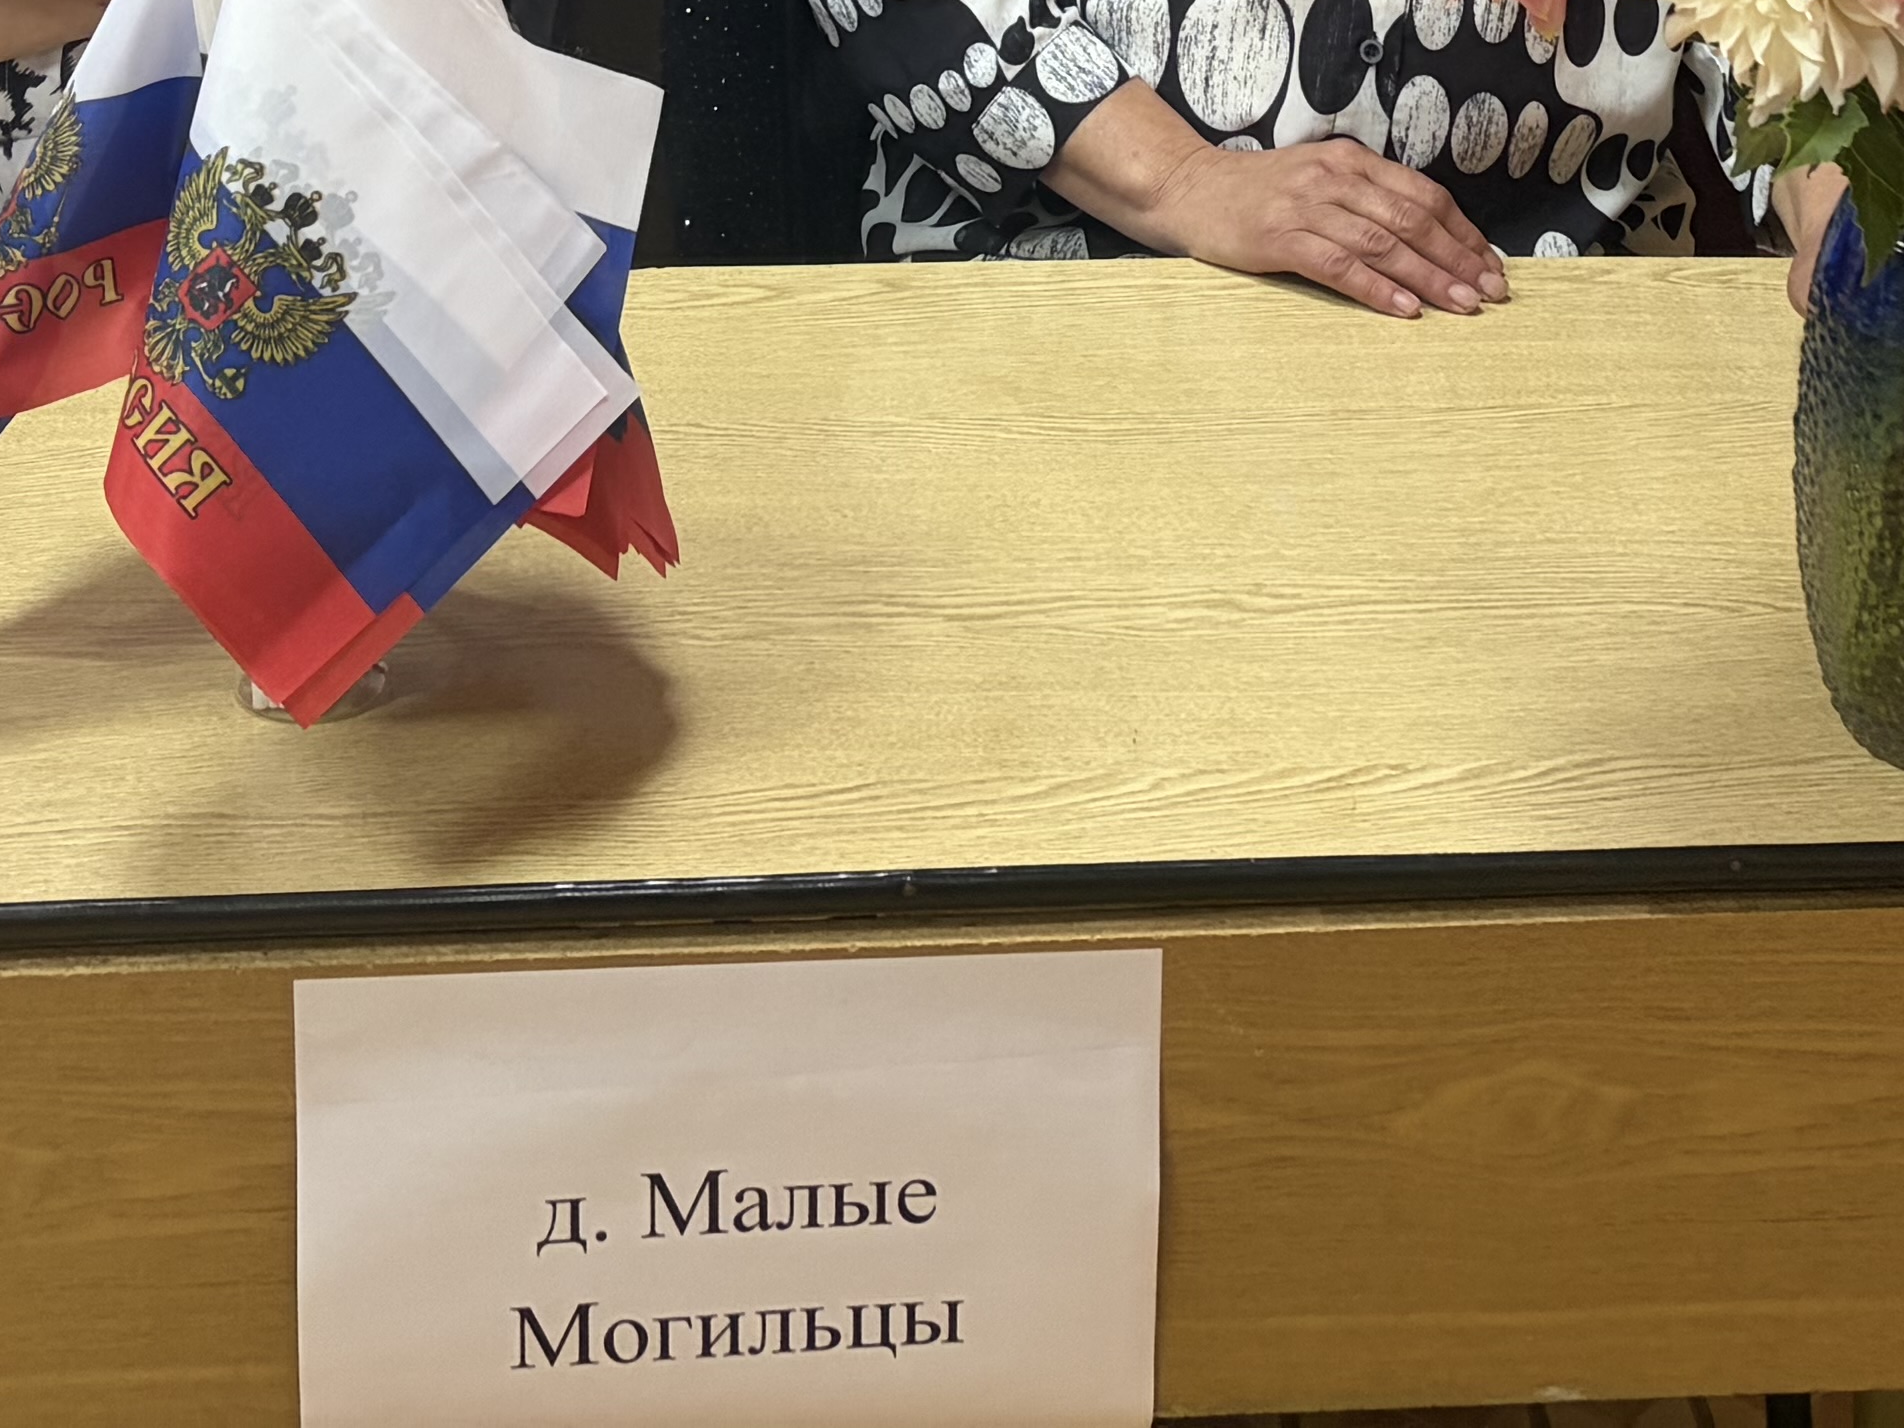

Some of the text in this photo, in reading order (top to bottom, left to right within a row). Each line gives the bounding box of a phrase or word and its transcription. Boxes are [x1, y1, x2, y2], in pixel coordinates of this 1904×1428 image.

[535, 1168, 939, 1257] д. Малые
[509, 1298, 965, 1371] Могильцы
